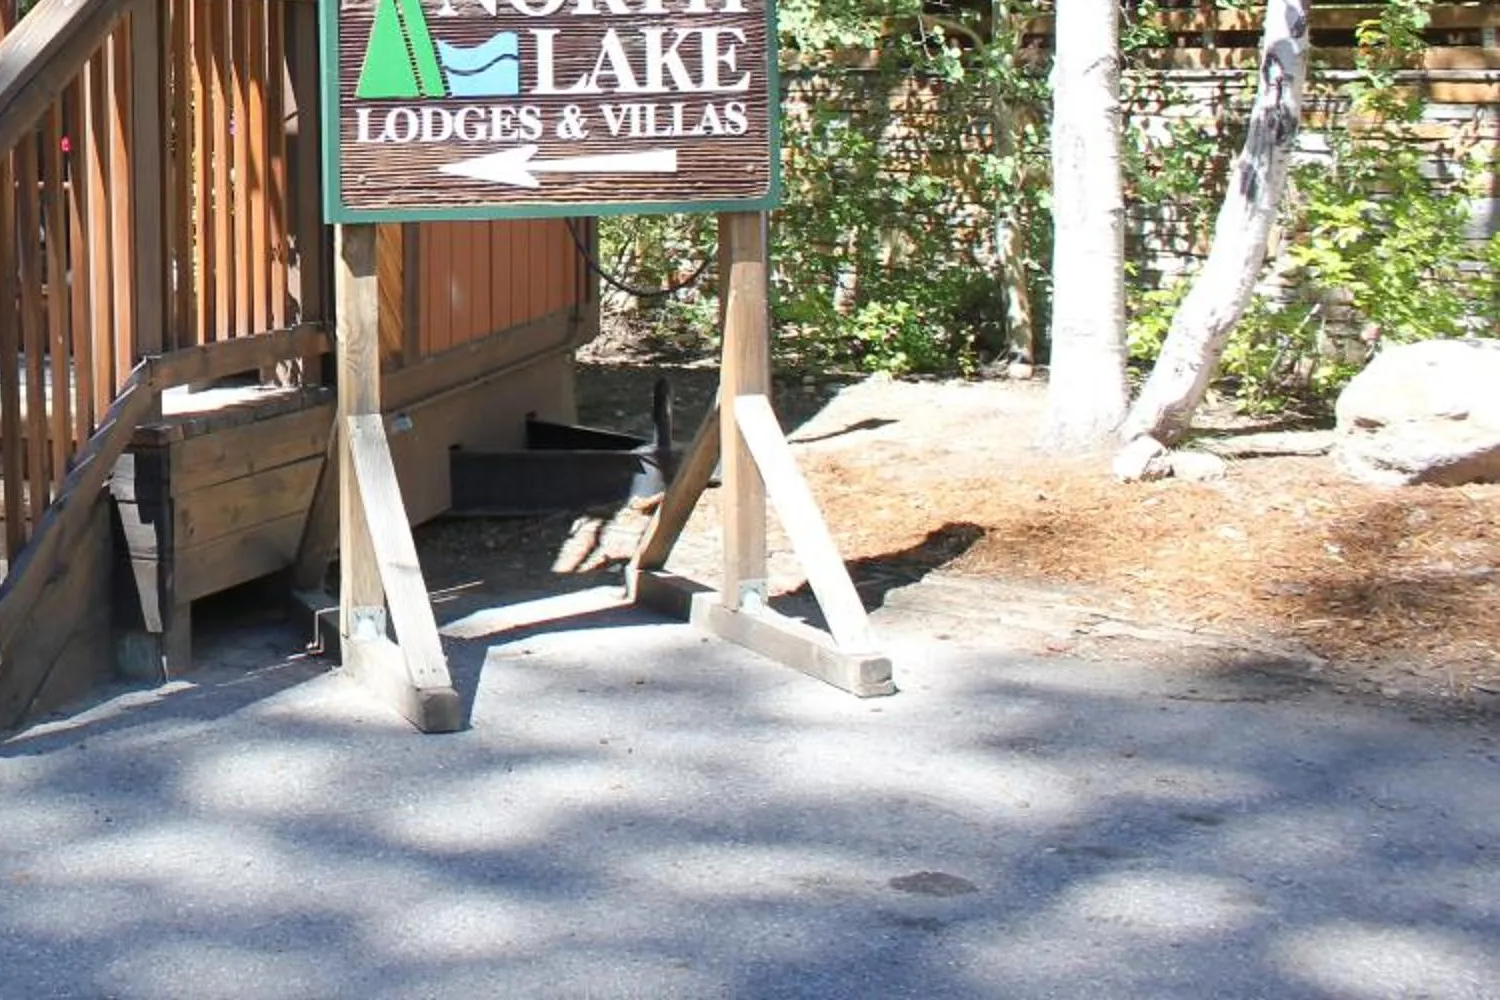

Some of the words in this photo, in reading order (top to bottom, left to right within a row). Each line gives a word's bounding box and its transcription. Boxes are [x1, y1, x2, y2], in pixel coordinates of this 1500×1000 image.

[529, 27, 749, 95] LAKE
[356, 107, 543, 143] LODGES
[556, 105, 589, 141] &
[600, 102, 748, 138] VILLAS
